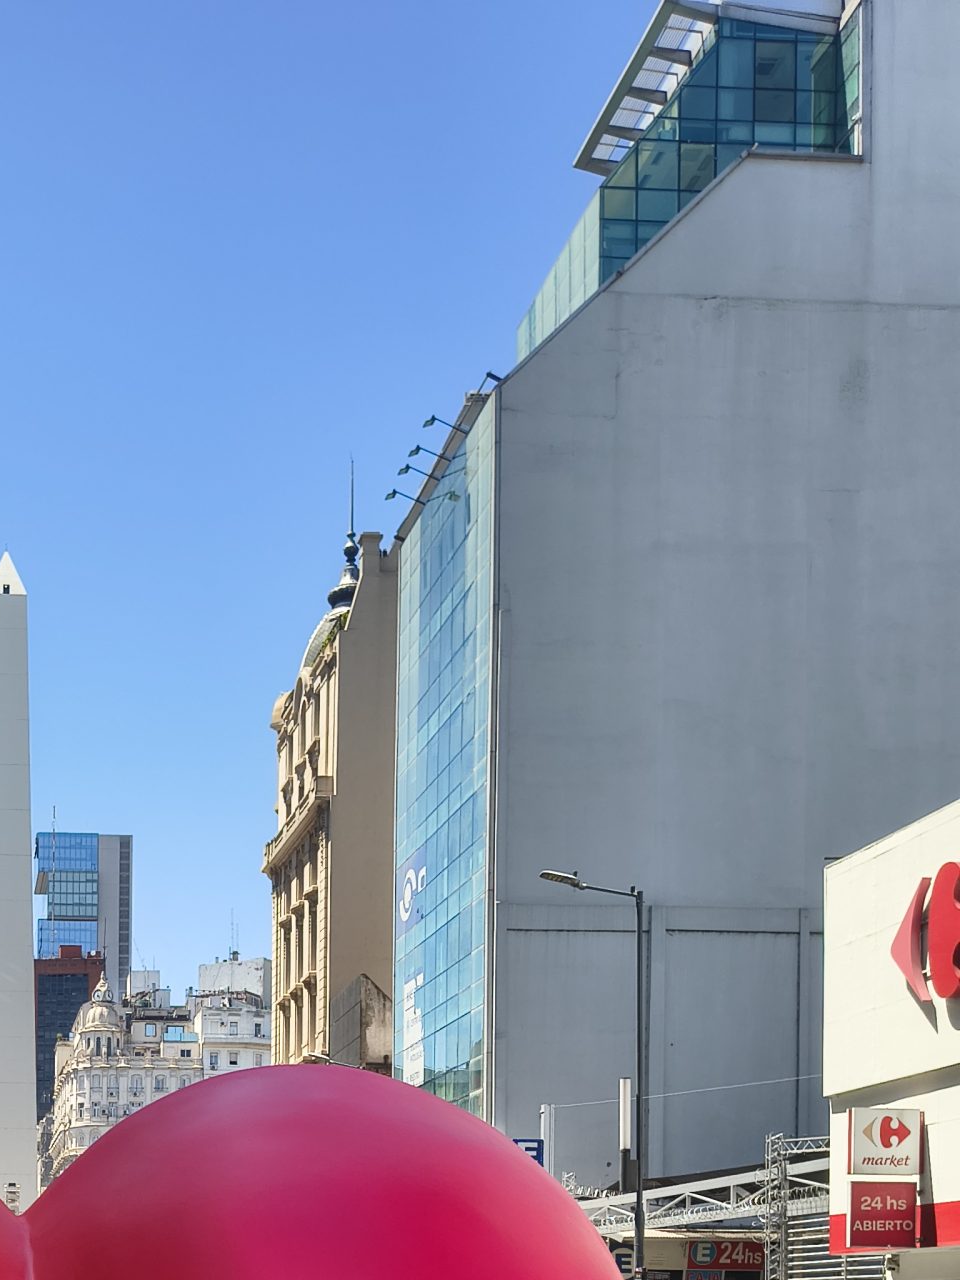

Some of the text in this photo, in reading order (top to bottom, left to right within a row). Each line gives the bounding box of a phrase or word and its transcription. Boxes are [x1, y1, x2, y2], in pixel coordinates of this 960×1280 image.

[862, 1154, 910, 1167] market
[860, 1195, 907, 1211] 24 hs
[853, 1220, 913, 1231] ABIERTO
[696, 1243, 711, 1263] E
